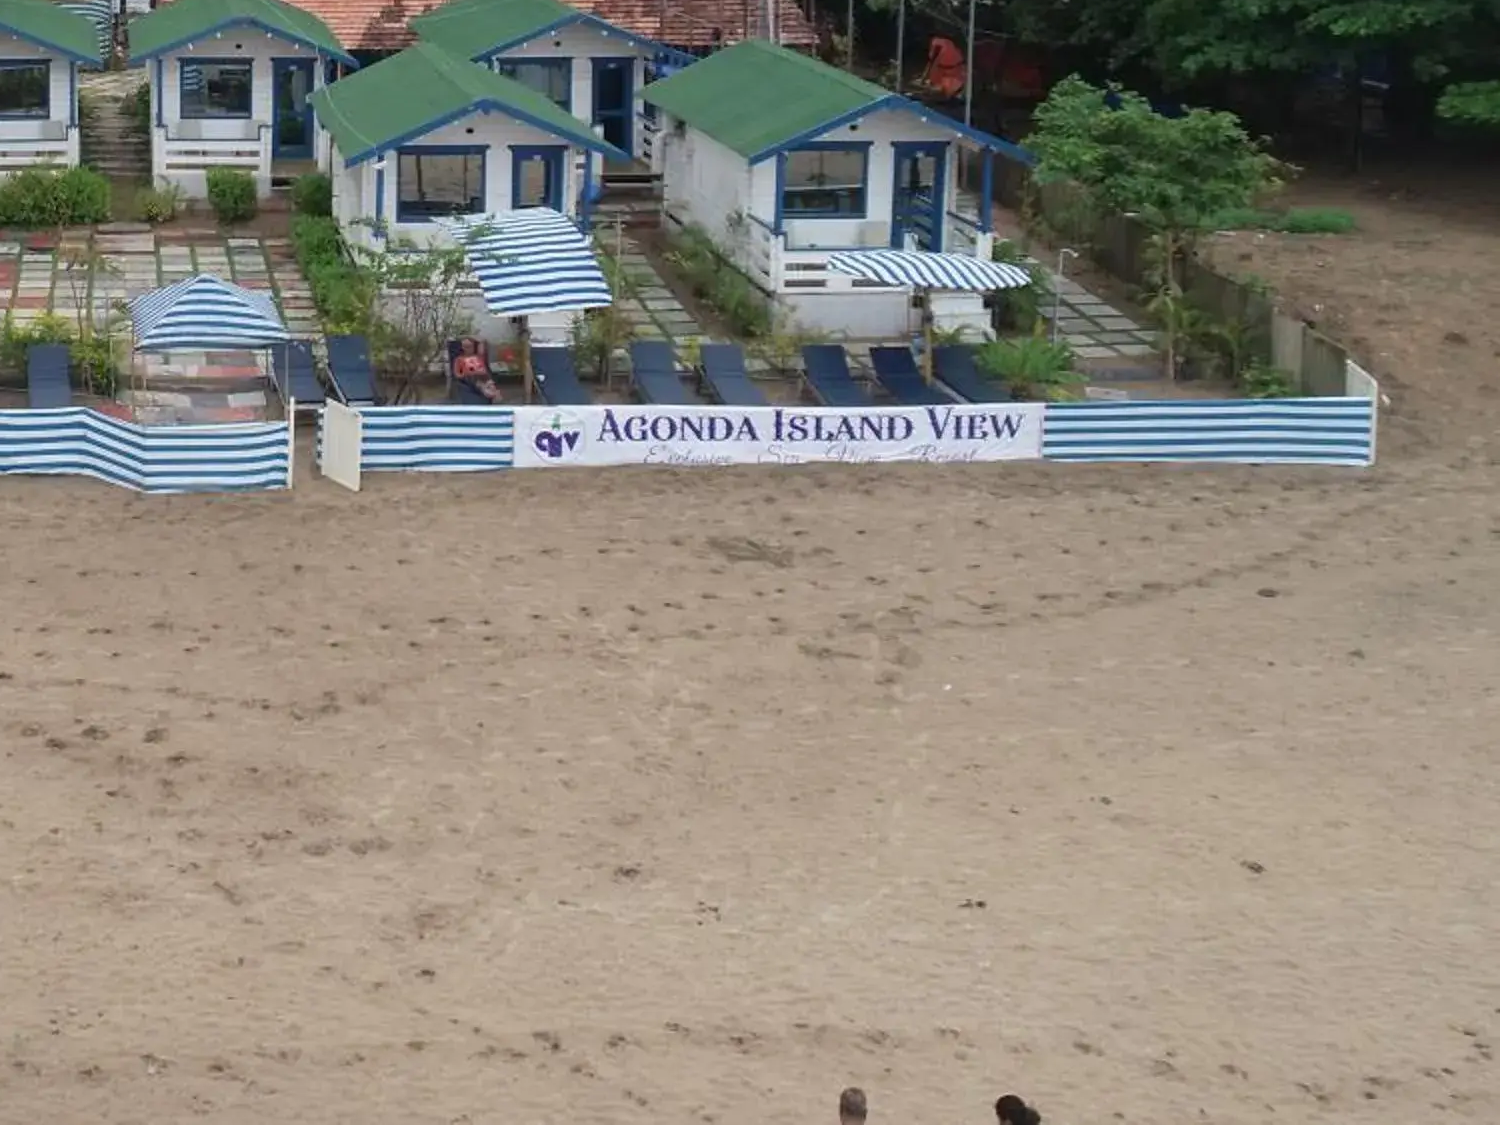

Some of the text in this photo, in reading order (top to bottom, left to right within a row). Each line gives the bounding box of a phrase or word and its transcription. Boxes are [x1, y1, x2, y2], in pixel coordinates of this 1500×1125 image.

[596, 406, 1027, 442] AGONDA ISLAND VIEW
